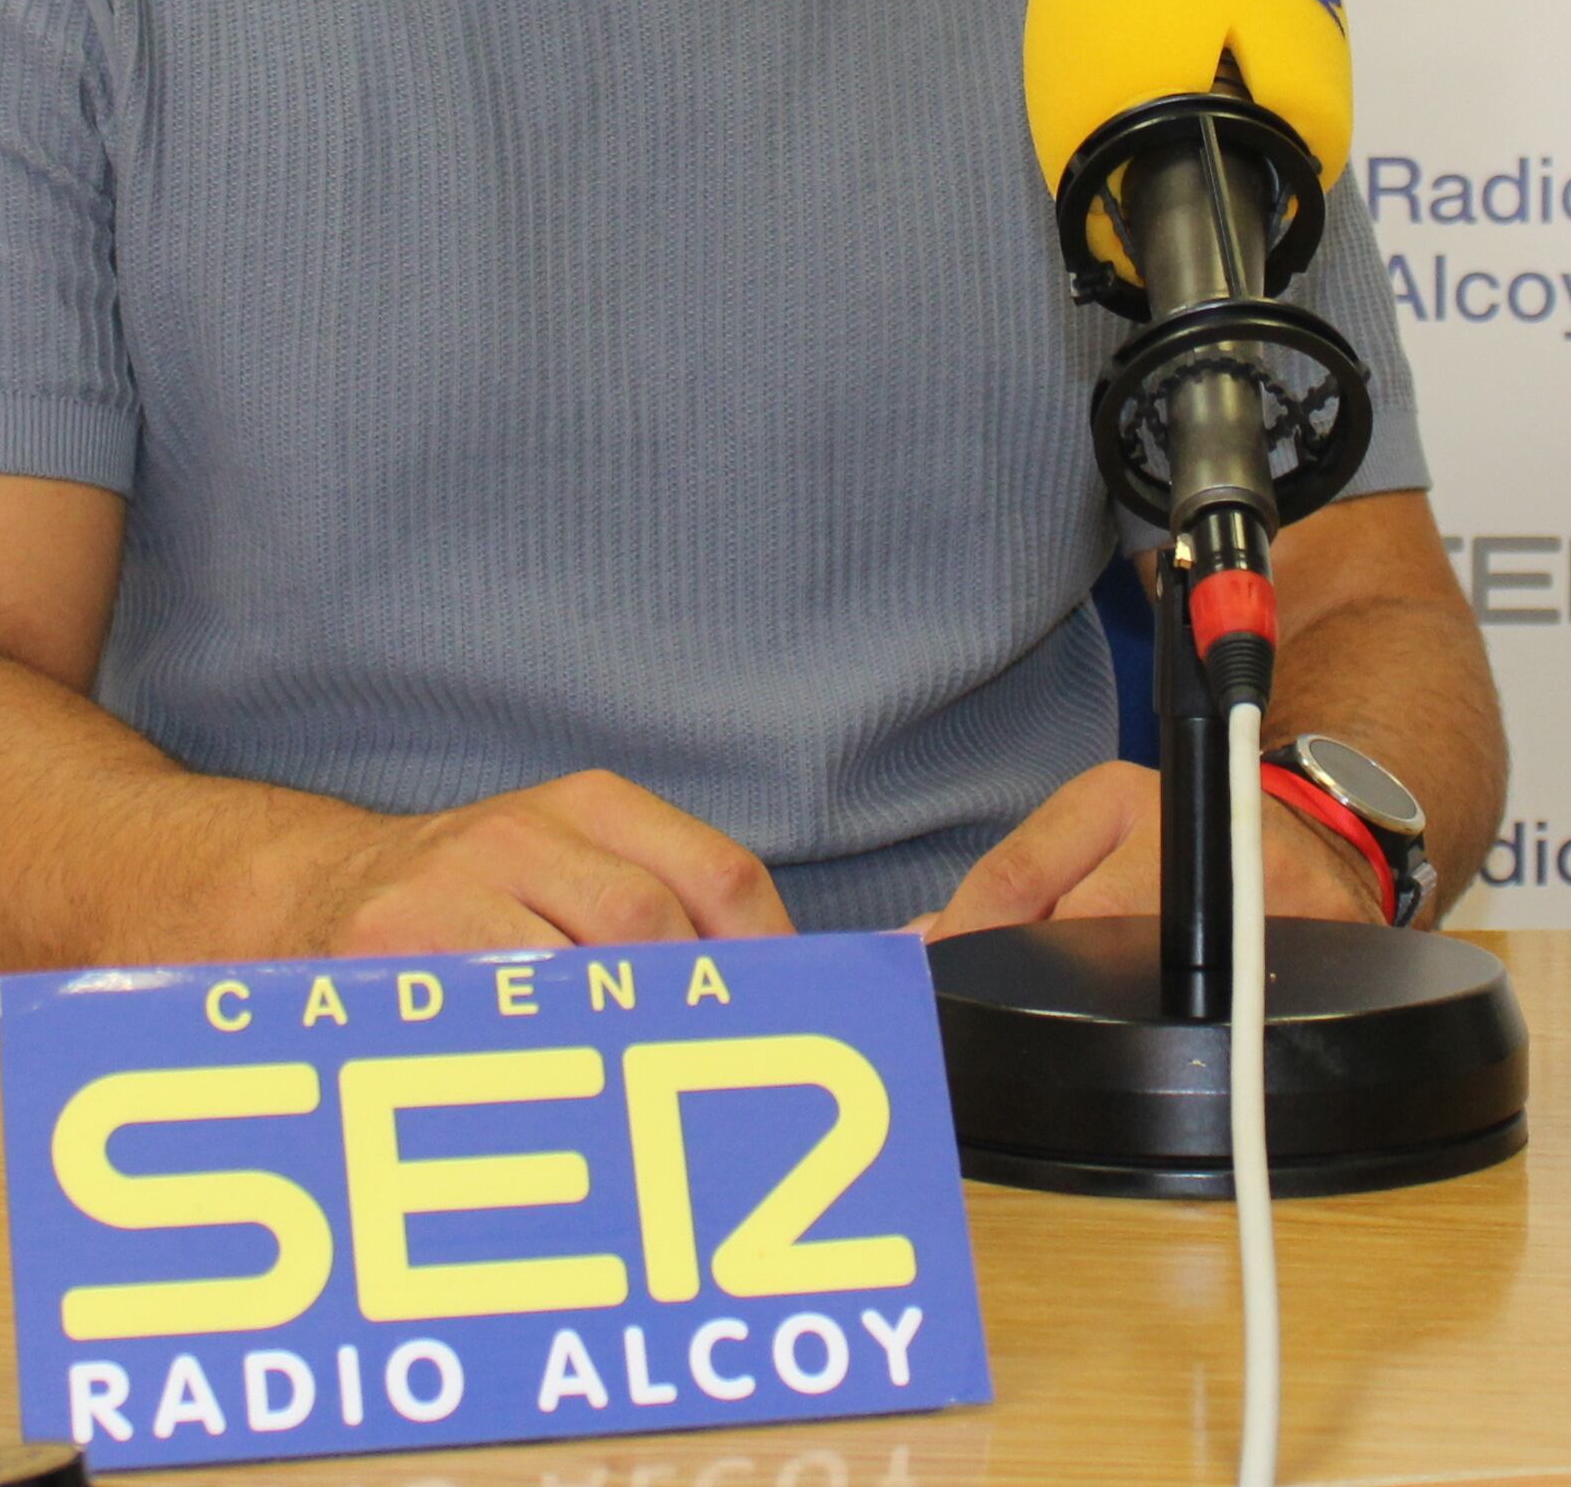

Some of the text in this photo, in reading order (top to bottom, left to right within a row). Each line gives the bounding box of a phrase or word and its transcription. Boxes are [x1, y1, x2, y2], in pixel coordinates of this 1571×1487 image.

[204, 955, 732, 1034] CADENA
[50, 1032, 918, 1342] SER
[68, 1307, 923, 1443] RADIO ALCOY
